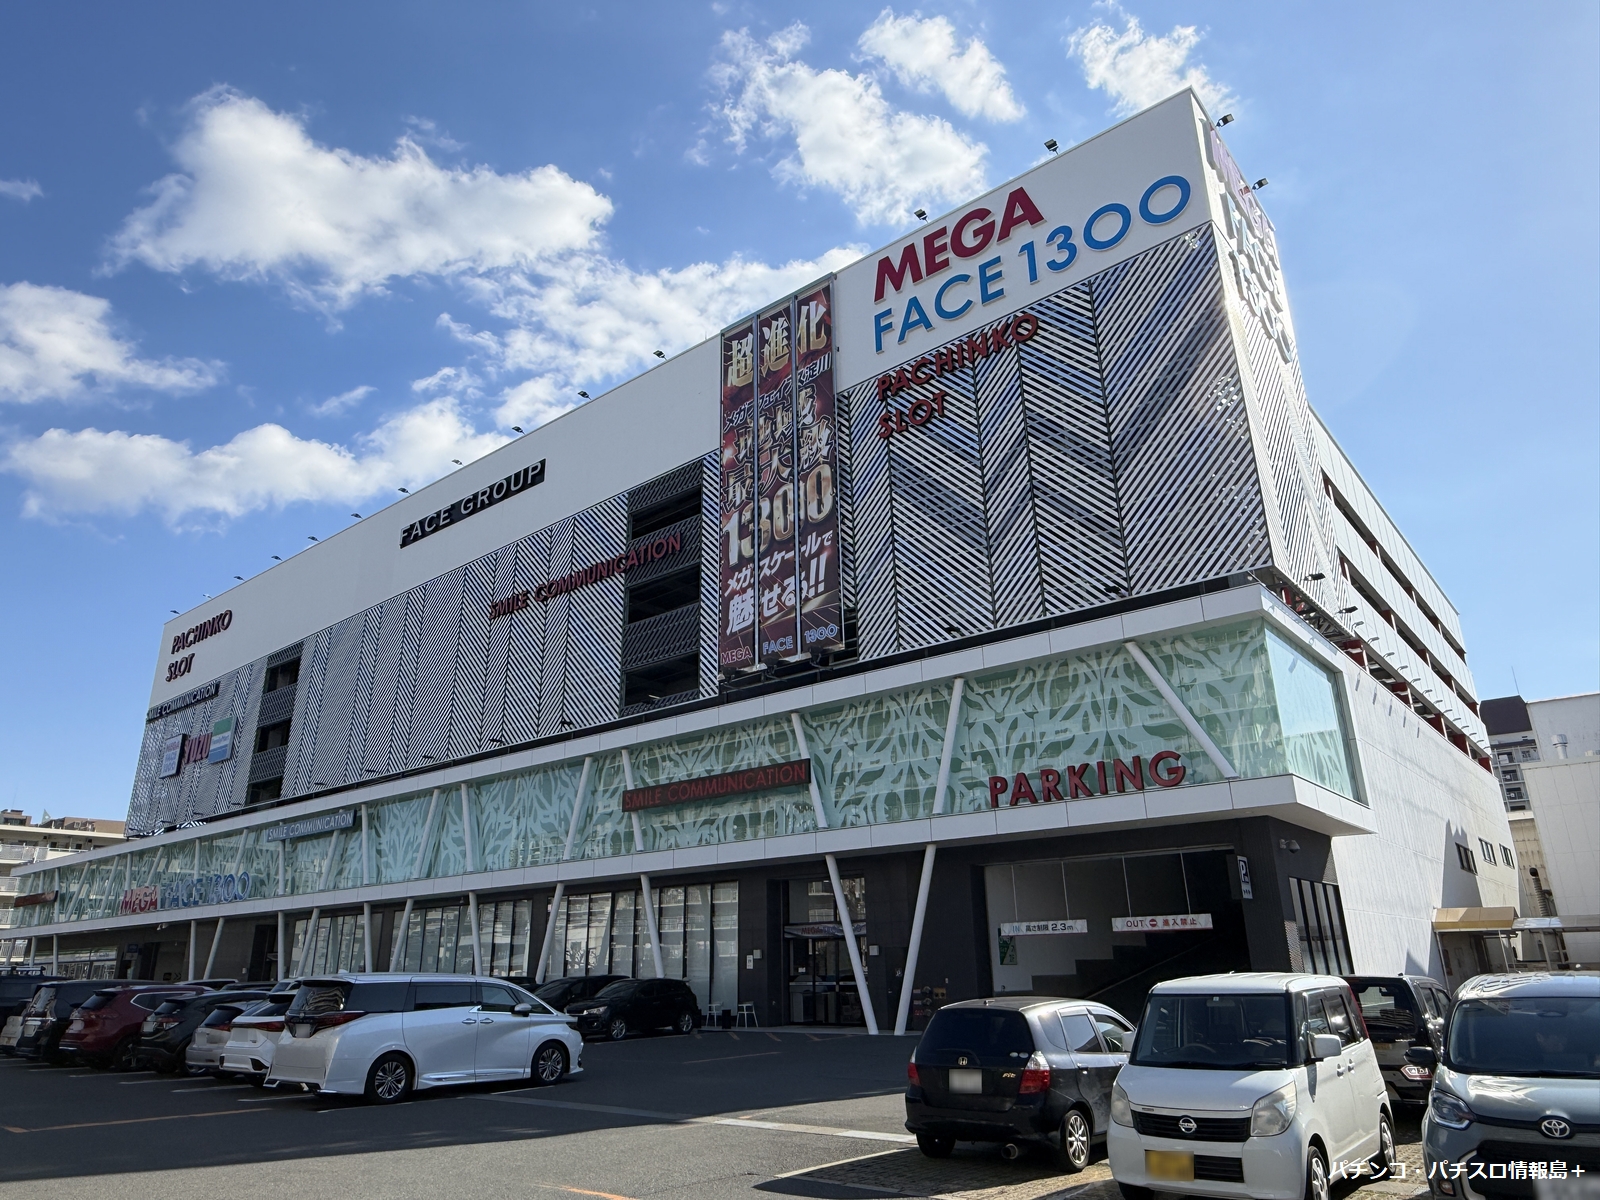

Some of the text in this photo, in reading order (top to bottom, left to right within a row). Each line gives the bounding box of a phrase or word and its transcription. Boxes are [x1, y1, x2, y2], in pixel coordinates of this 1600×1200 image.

[874, 187, 1046, 304] MEGA
[874, 175, 1191, 354] FACE 1300
[727, 301, 828, 387] 超進化
[877, 313, 1039, 400] PACHINKO
[877, 390, 947, 440] SLOT
[400, 462, 542, 545] FACE GROUP
[721, 464, 833, 566] 1300
[489, 531, 681, 619] SMILE COMMUNICATION
[724, 530, 833, 597] メガスケールで
[726, 552, 828, 636] 魅せる!!
[171, 609, 232, 654] PACHINKO
[720, 624, 838, 665] MEGA FACE 1300
[165, 653, 195, 682] SLOT
[625, 763, 806, 808] SMILE COMMUNICATION
[988, 750, 1186, 808] PARKING
[268, 812, 353, 840] SMILE COMMUNICATION
[120, 884, 159, 914] MEGA
[208, 871, 250, 904] 1300
[1051, 922, 1074, 931] 2.3m
[1126, 917, 1197, 928] OUT 進入禁止
